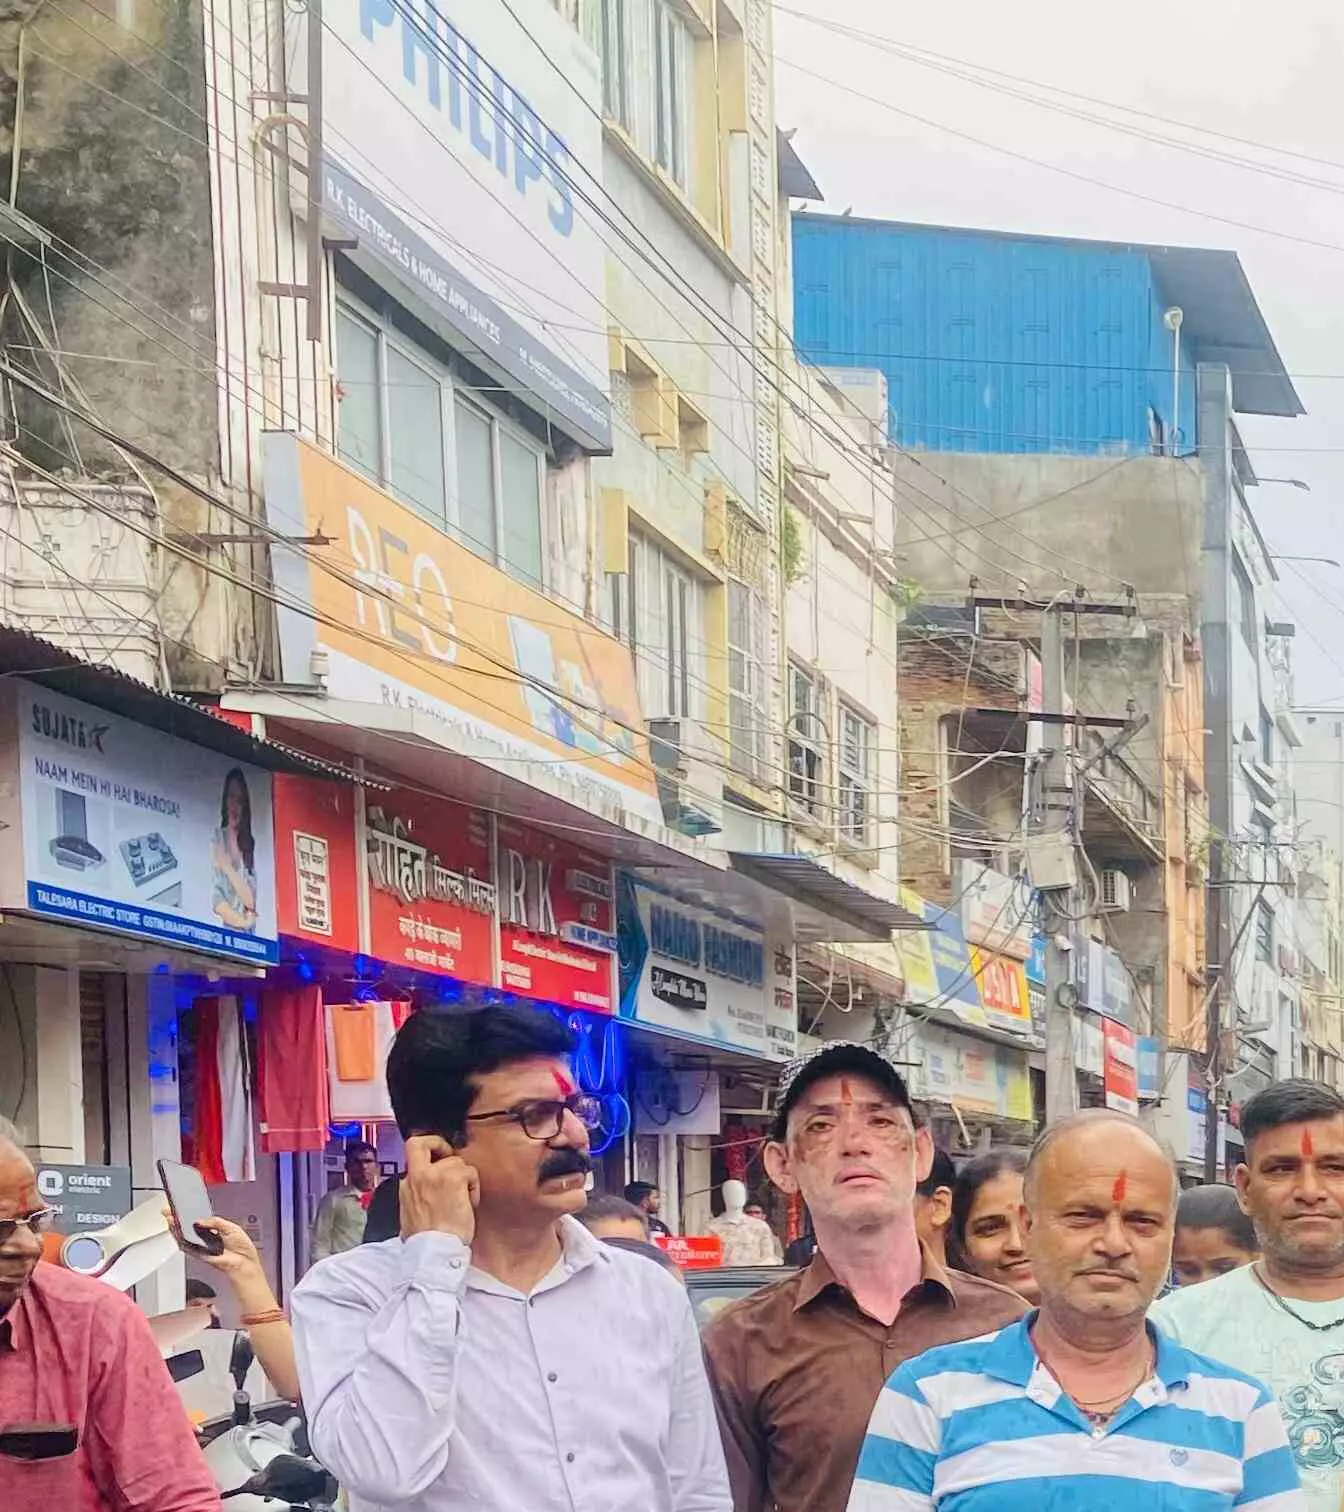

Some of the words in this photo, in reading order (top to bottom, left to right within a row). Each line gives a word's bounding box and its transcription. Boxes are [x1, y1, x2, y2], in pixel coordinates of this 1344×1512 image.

[346, 505, 457, 664] REO
[32, 702, 87, 750] SUJATA
[34, 757, 68, 783] NAAM
[71, 769, 98, 793] MEIN
[113, 785, 132, 804] HAI
[68, 1172, 112, 1187] orient
[76, 1212, 121, 1224] DESIGN
